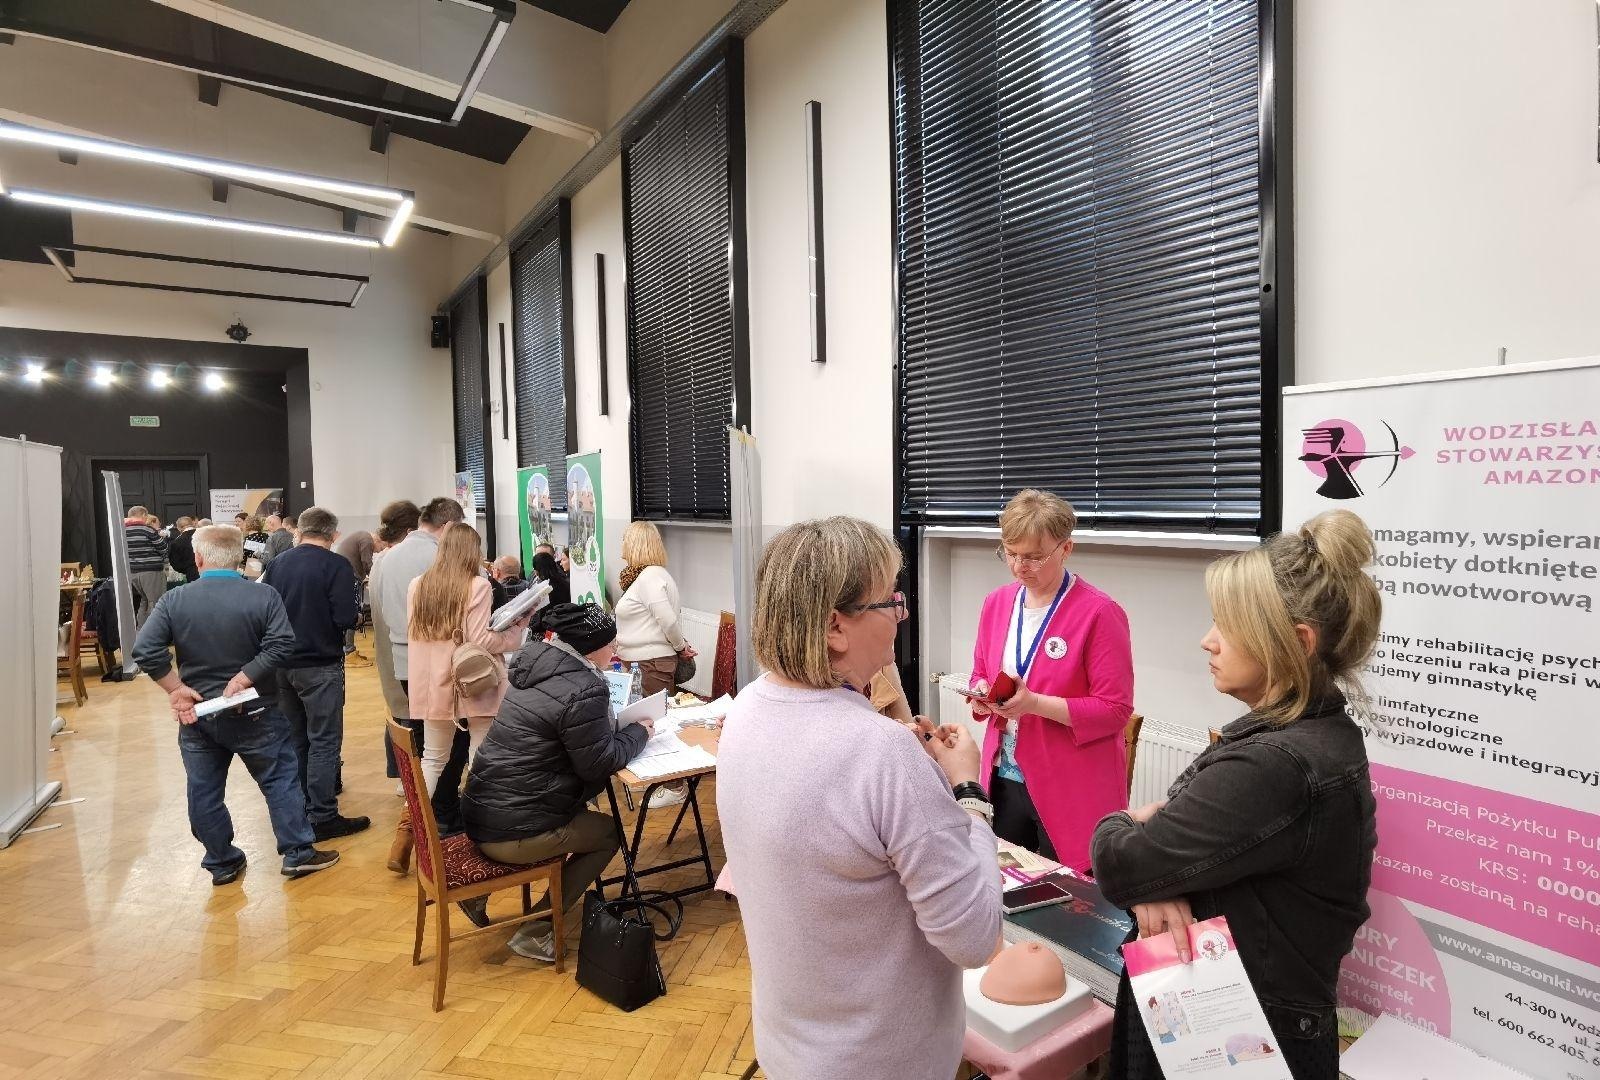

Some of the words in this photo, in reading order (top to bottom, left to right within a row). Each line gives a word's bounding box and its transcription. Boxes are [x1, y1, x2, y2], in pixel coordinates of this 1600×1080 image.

[1443, 420, 1598, 442] WODZISŁA
[1436, 444, 1600, 464] STOWARZY
[1370, 528, 1476, 548] magamy,
[1464, 554, 1598, 581] dotknięte
[1402, 580, 1592, 613] nowotworową
[1416, 637, 1534, 664] rehabilitację
[1391, 649, 1462, 669] leczeniu
[1469, 661, 1511, 676] raka
[1518, 667, 1577, 686] piersi
[1427, 672, 1537, 701] gimnastykę
[1378, 695, 1479, 723] limfatyczne
[1377, 728, 1474, 757] wyjazdowe
[1480, 748, 1486, 759] i
[1492, 750, 1600, 787] integracyj
[1477, 806, 1557, 839] Pożytku
[1426, 819, 1499, 850] Przekaż
[1506, 843, 1552, 866] nam
[1562, 857, 1600, 879] 1%
[1373, 850, 1433, 879] kazane
[1440, 873, 1517, 911] zostaną
[1523, 900, 1548, 918] na
[1480, 857, 1527, 884] KRS:
[1504, 992, 1557, 1019] 44-300
[1473, 1006, 1494, 1022] tel.
[1497, 1017, 1524, 1035] 600
[1528, 1030, 1554, 1048] 662
[1575, 1036, 1591, 1048] ul.
